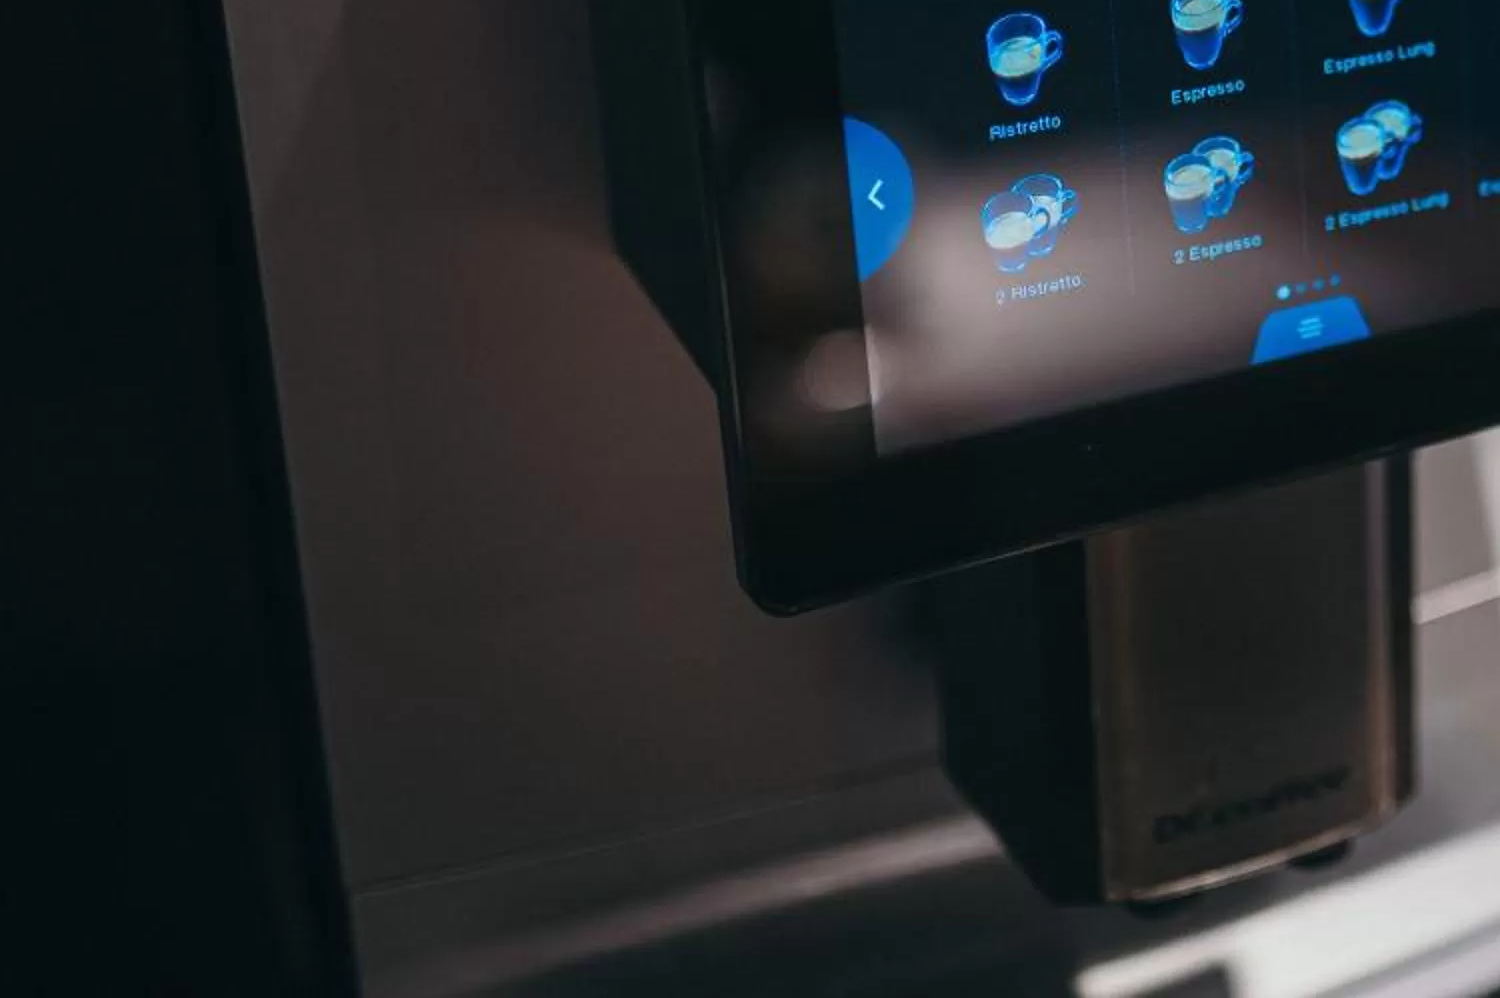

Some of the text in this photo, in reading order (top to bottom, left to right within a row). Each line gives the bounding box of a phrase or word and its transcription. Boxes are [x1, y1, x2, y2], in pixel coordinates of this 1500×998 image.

[1323, 41, 1436, 74] Espresso Lung
[1170, 79, 1246, 105] Espresso
[989, 115, 1062, 141] Ristretto
[1338, 201, 1409, 228] Espresso
[1411, 190, 1450, 212] Lung
[1172, 234, 1263, 265] 2 Espresso
